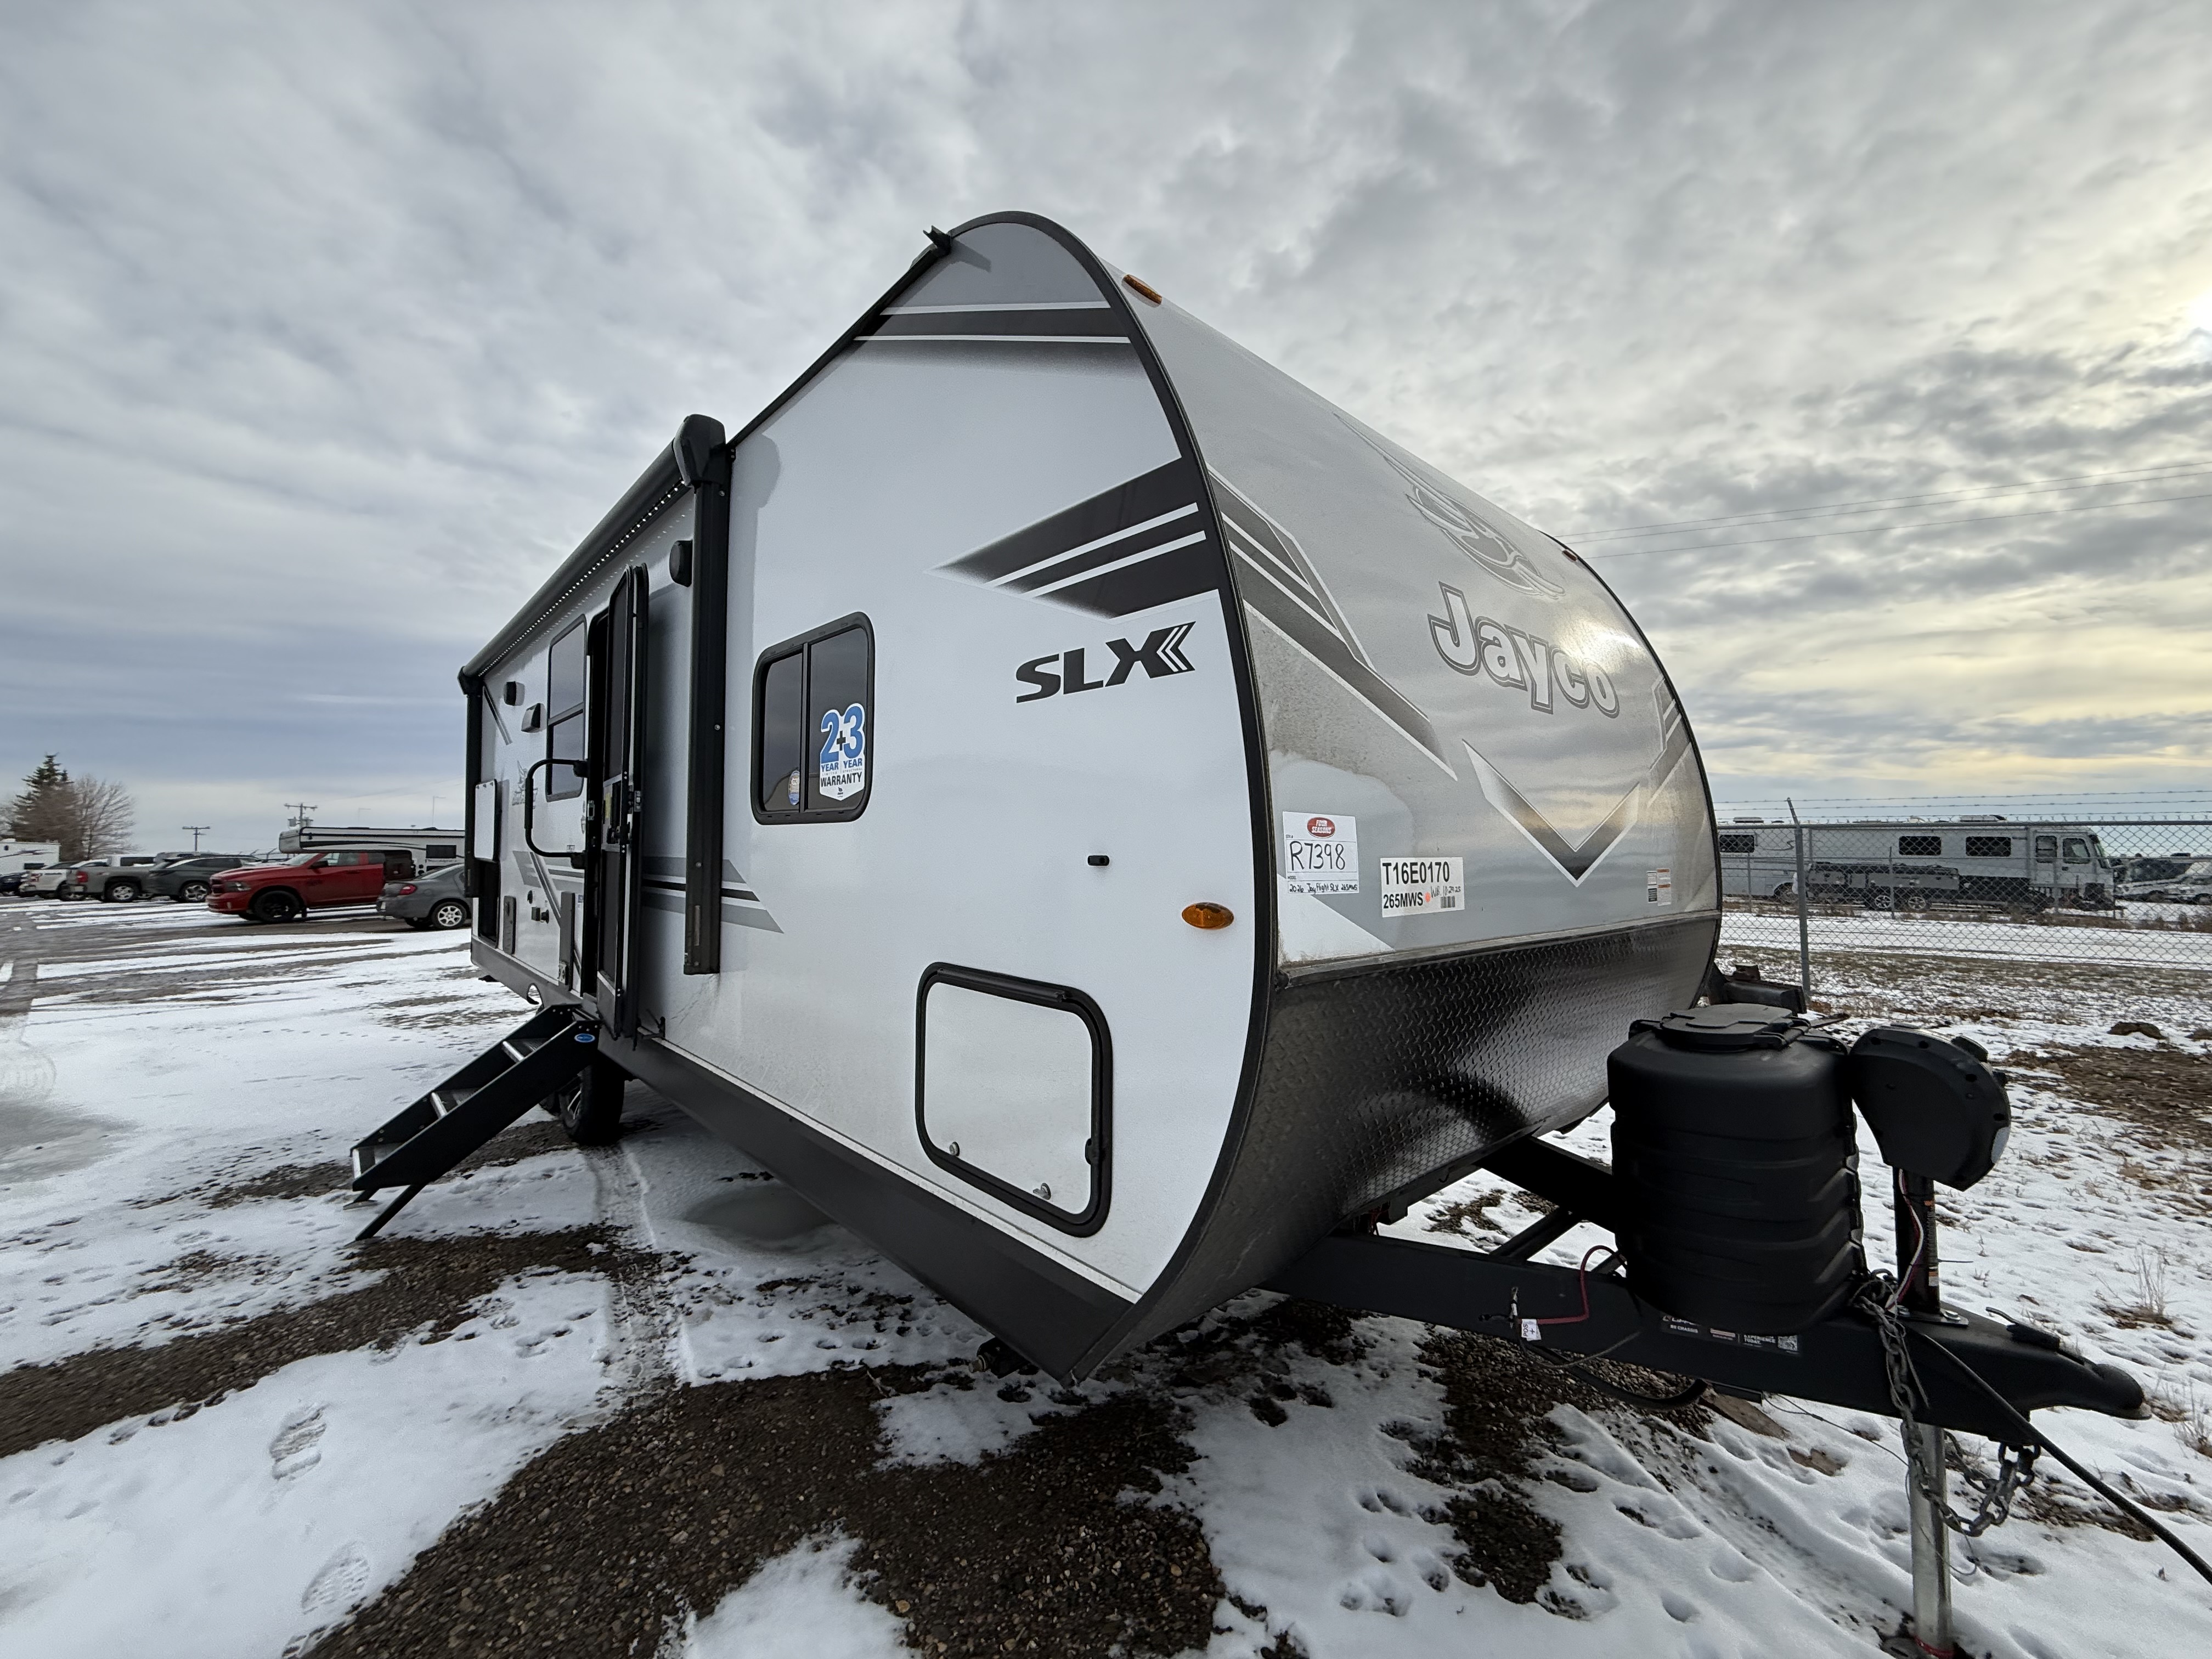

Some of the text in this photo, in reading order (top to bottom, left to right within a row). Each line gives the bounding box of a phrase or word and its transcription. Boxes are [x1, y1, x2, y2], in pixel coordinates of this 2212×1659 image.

[1427, 580, 1620, 719] Jayco
[1015, 621, 1197, 704] SLX
[821, 758, 862, 772] YEAR YEAR
[821, 772, 862, 787] WARRANTY
[1289, 840, 1346, 871] R7398
[1382, 861, 1450, 885] T16E0170
[1383, 891, 1424, 909] 265MWS
